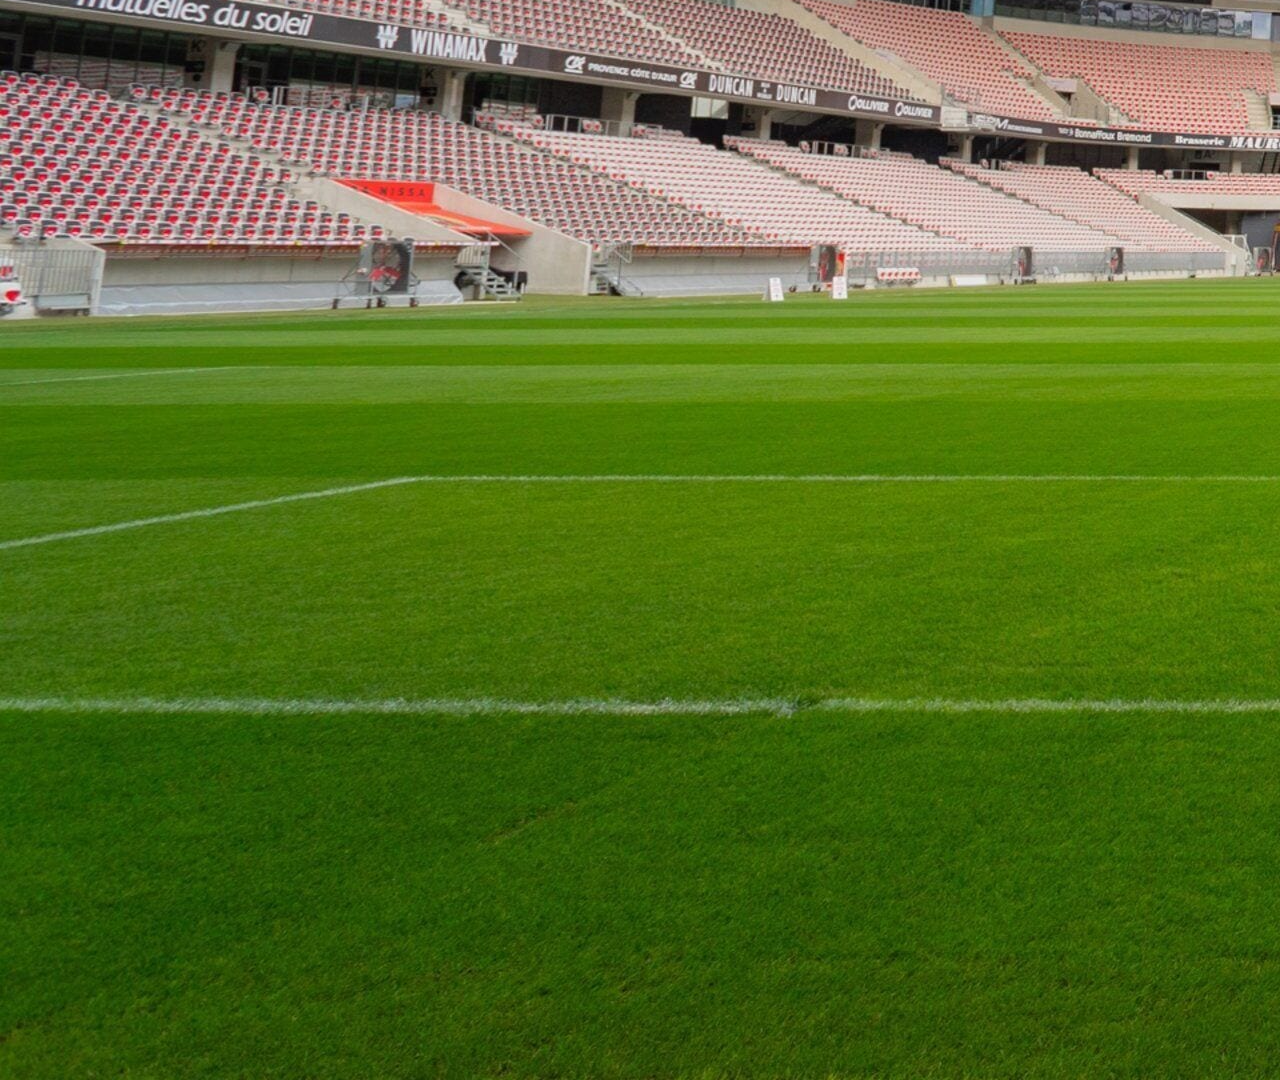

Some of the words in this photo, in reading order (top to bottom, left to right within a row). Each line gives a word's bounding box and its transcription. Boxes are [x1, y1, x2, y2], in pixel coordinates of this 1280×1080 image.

[214, 3, 250, 28] du
[252, 11, 314, 37] soleil
[411, 28, 489, 63] WINAMAX
[587, 62, 630, 76] PROVENCE
[651, 71, 677, 82] D'AZUR
[708, 74, 754, 97] DUNCAN
[776, 84, 817, 105] DUNCAN
[1174, 135, 1225, 147] Brasserie
[379, 187, 425, 197] NISSA
